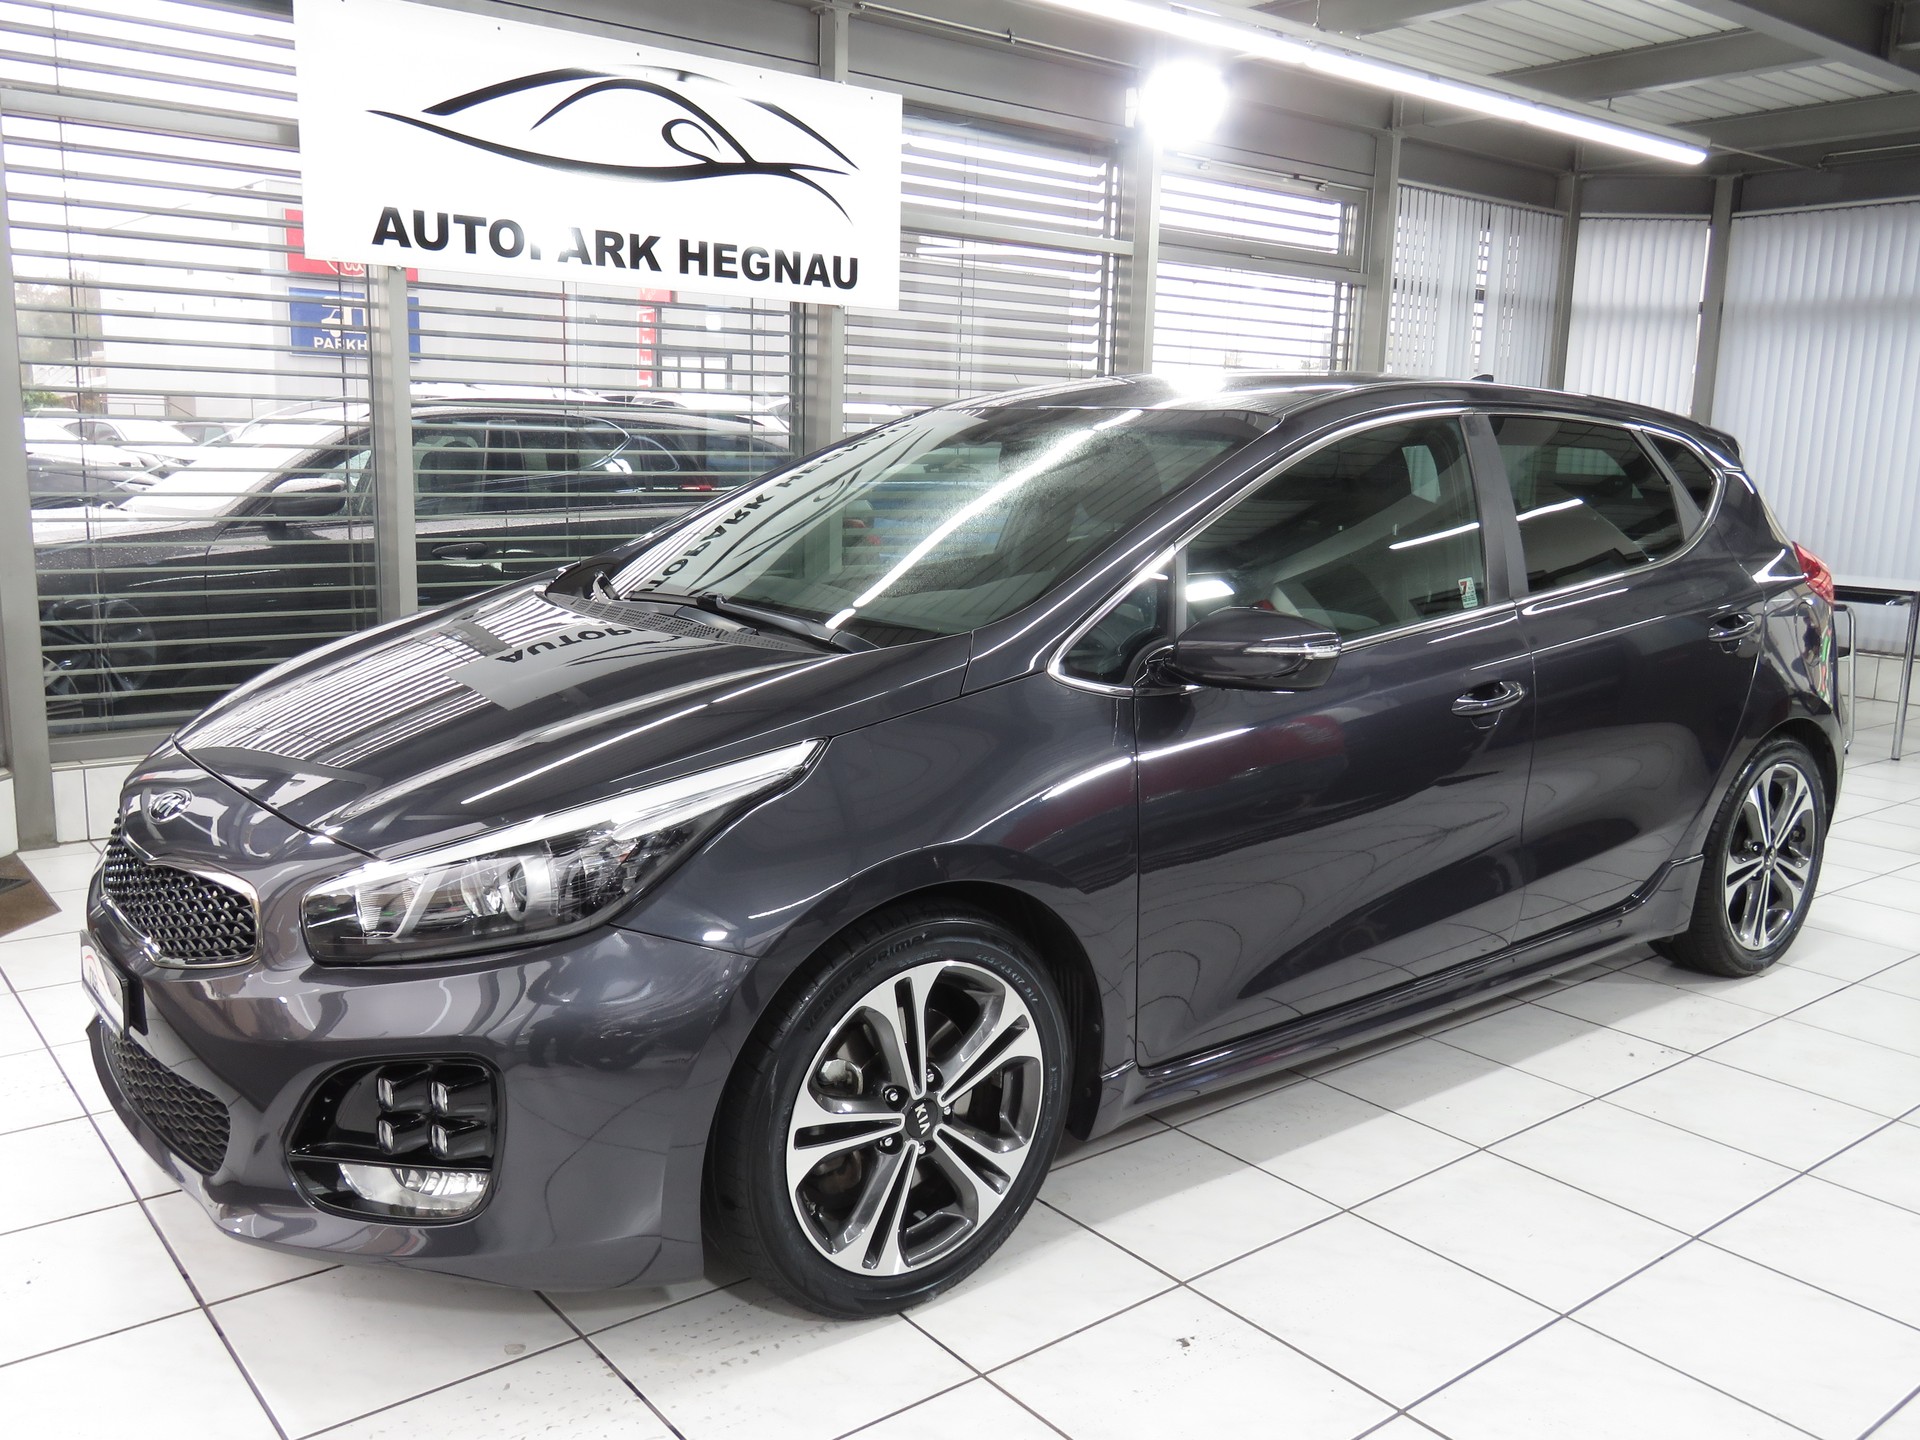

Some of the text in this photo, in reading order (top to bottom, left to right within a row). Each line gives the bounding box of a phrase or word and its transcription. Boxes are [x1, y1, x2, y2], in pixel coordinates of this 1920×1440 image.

[372, 206, 858, 290] AUTOARK HEGNAU
[313, 336, 368, 353] PARKH
[914, 1103, 931, 1136] KIA
